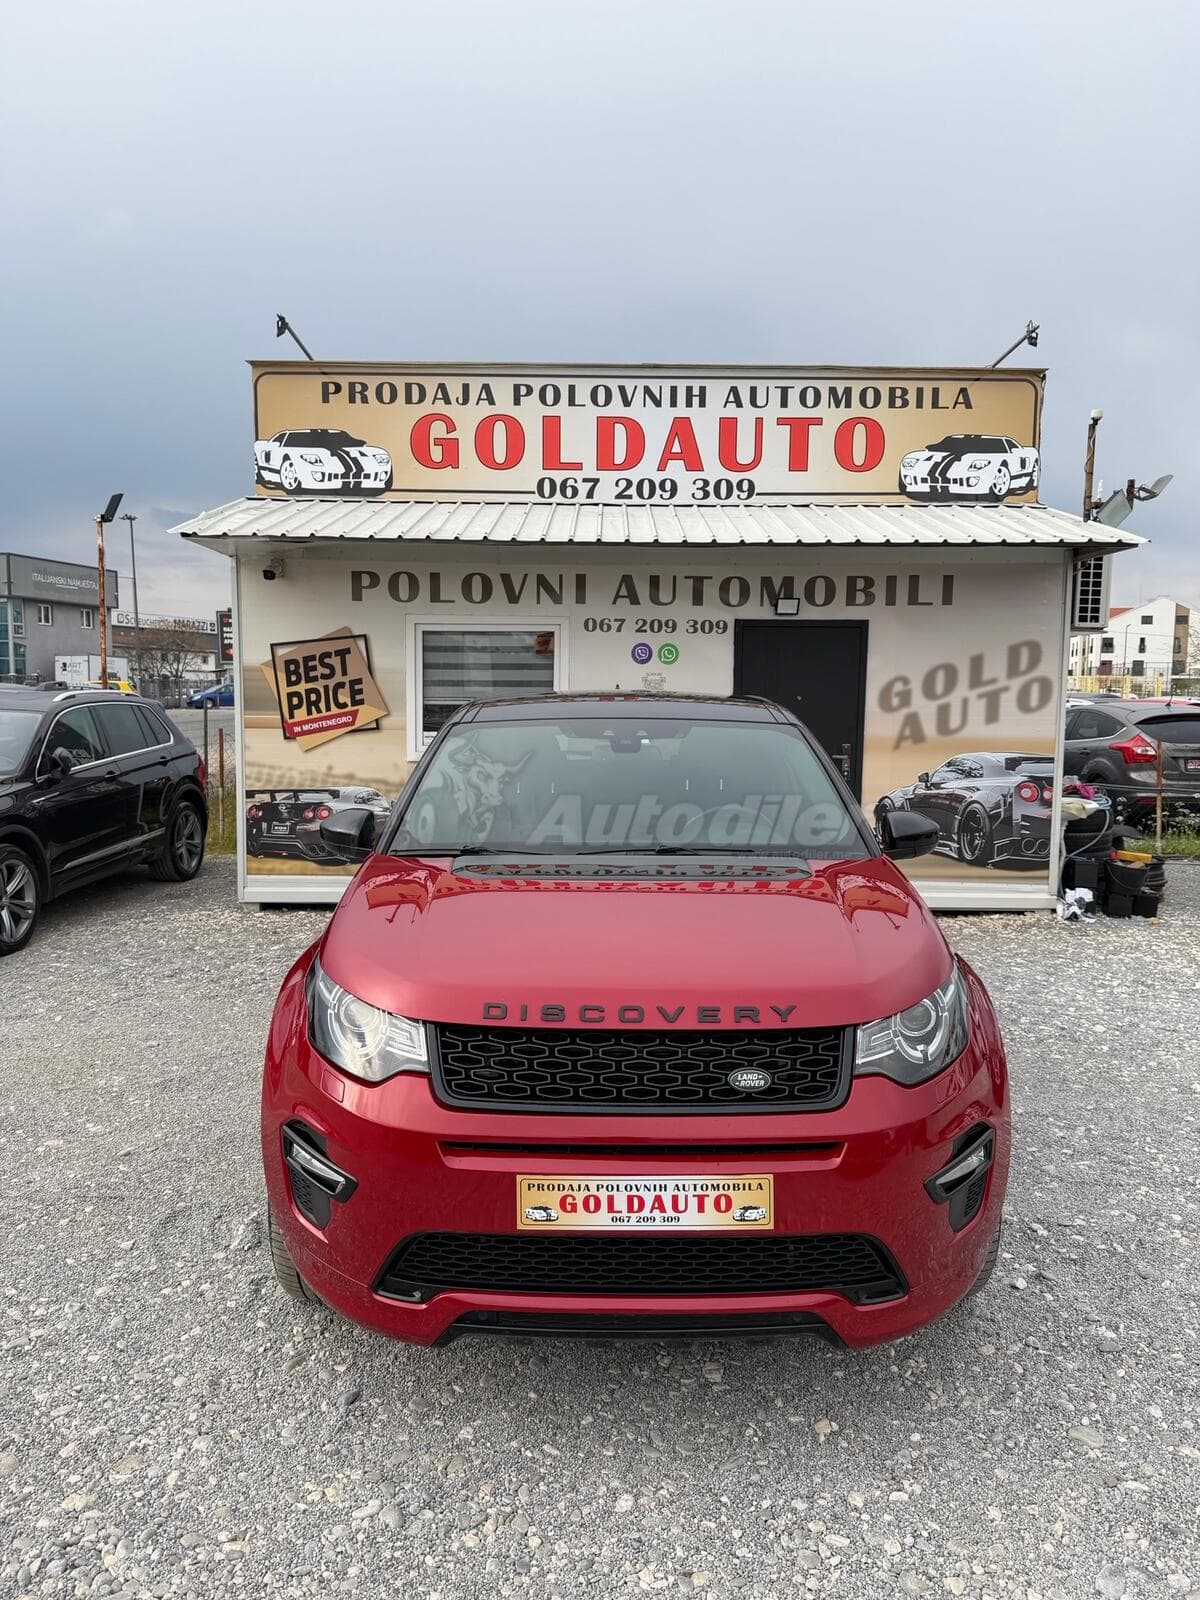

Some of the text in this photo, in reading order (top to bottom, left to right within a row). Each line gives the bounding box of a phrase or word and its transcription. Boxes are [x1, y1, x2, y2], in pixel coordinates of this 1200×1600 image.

[320, 380, 974, 411] PRODAJA POLOVNIH AUTOMOBILA
[409, 412, 887, 474] GOLDAUTO
[536, 476, 756, 502] 067 209 309
[350, 570, 955, 608] POLOVNI AUTOMOBILI
[583, 617, 729, 636] 067 209 309
[284, 647, 352, 688] BEST
[878, 639, 1044, 714] GOLD
[286, 677, 365, 720] PRICE
[293, 715, 353, 733] IN MONTENEGRO
[893, 675, 1055, 751] AUTO
[482, 1002, 798, 1024] DISCOVERY
[527, 1182, 764, 1193] PRODAJA POLOVNIH AUTOMOBILA
[558, 1193, 733, 1214] GOLDAUTO
[611, 1215, 680, 1224] 067 209 309
